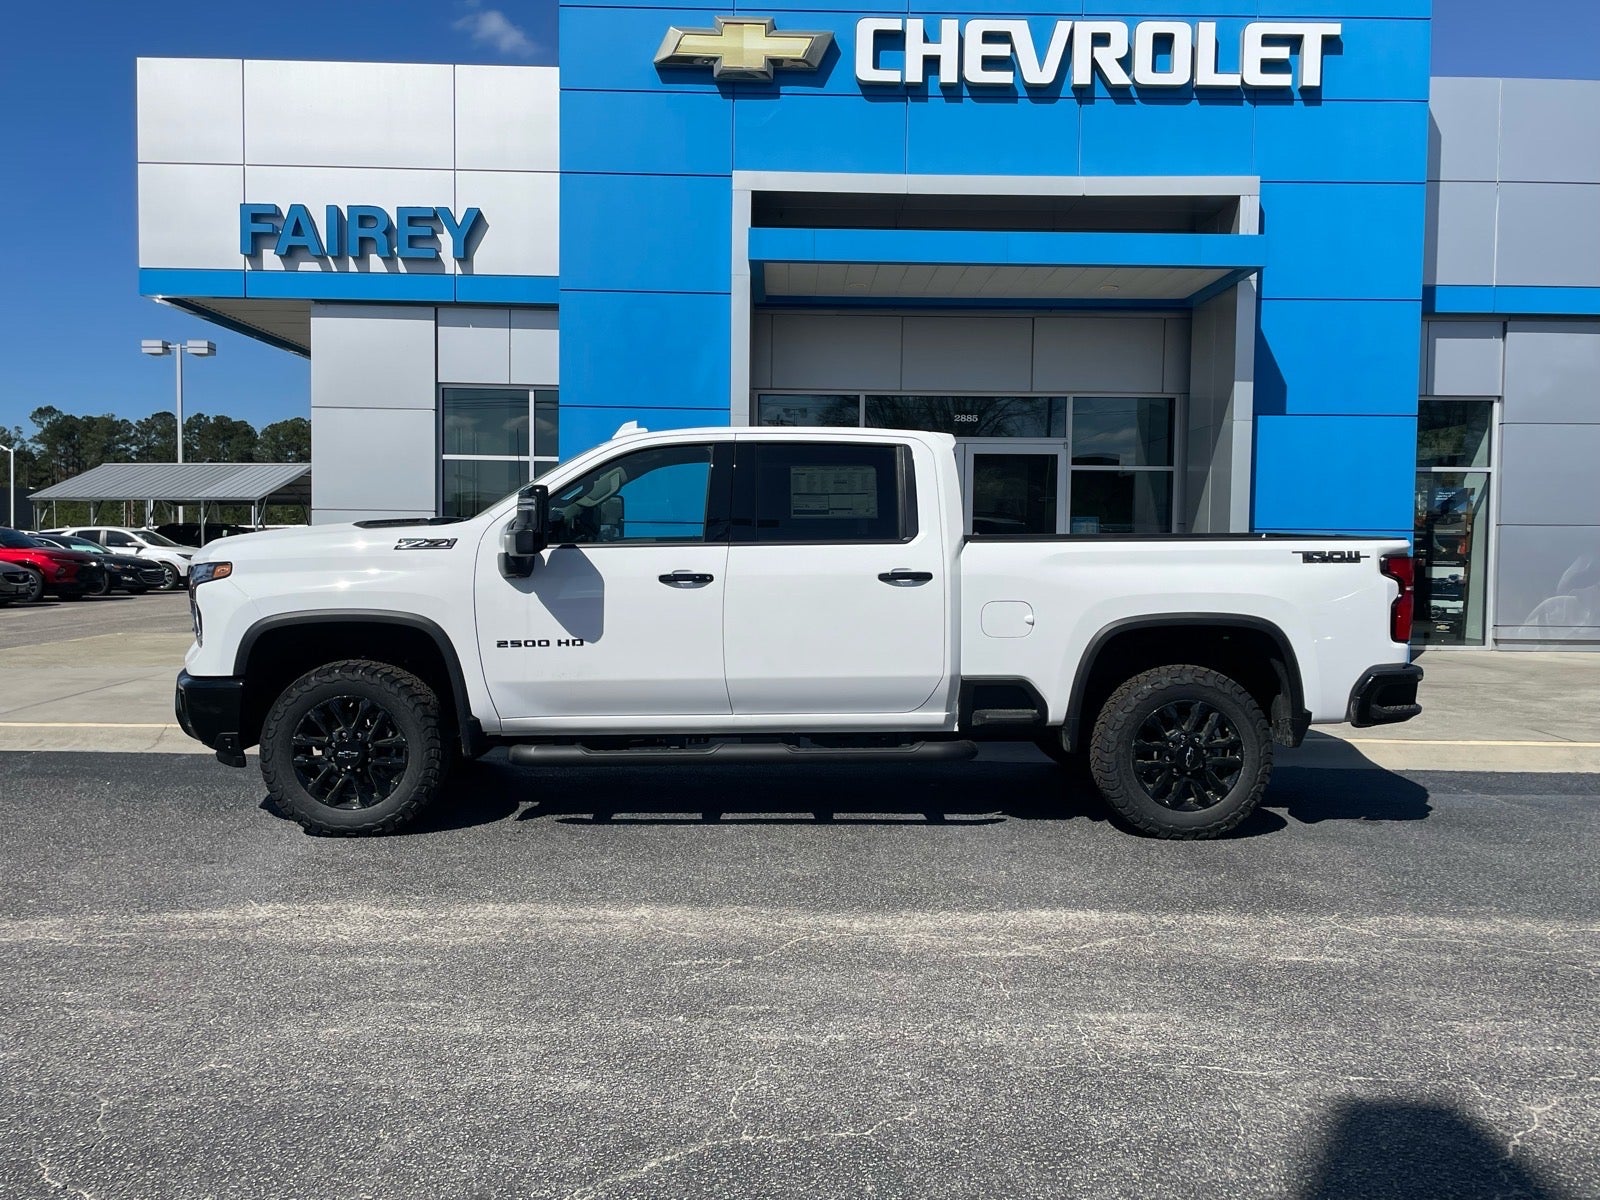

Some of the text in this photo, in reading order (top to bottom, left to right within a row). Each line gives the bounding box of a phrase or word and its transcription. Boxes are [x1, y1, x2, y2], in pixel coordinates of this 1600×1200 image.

[855, 17, 1343, 89] CHEVROLET
[239, 203, 482, 260] FAIREY
[953, 414, 979, 423] 2885
[393, 537, 459, 551] Z71
[496, 638, 584, 649] 2500 HD
